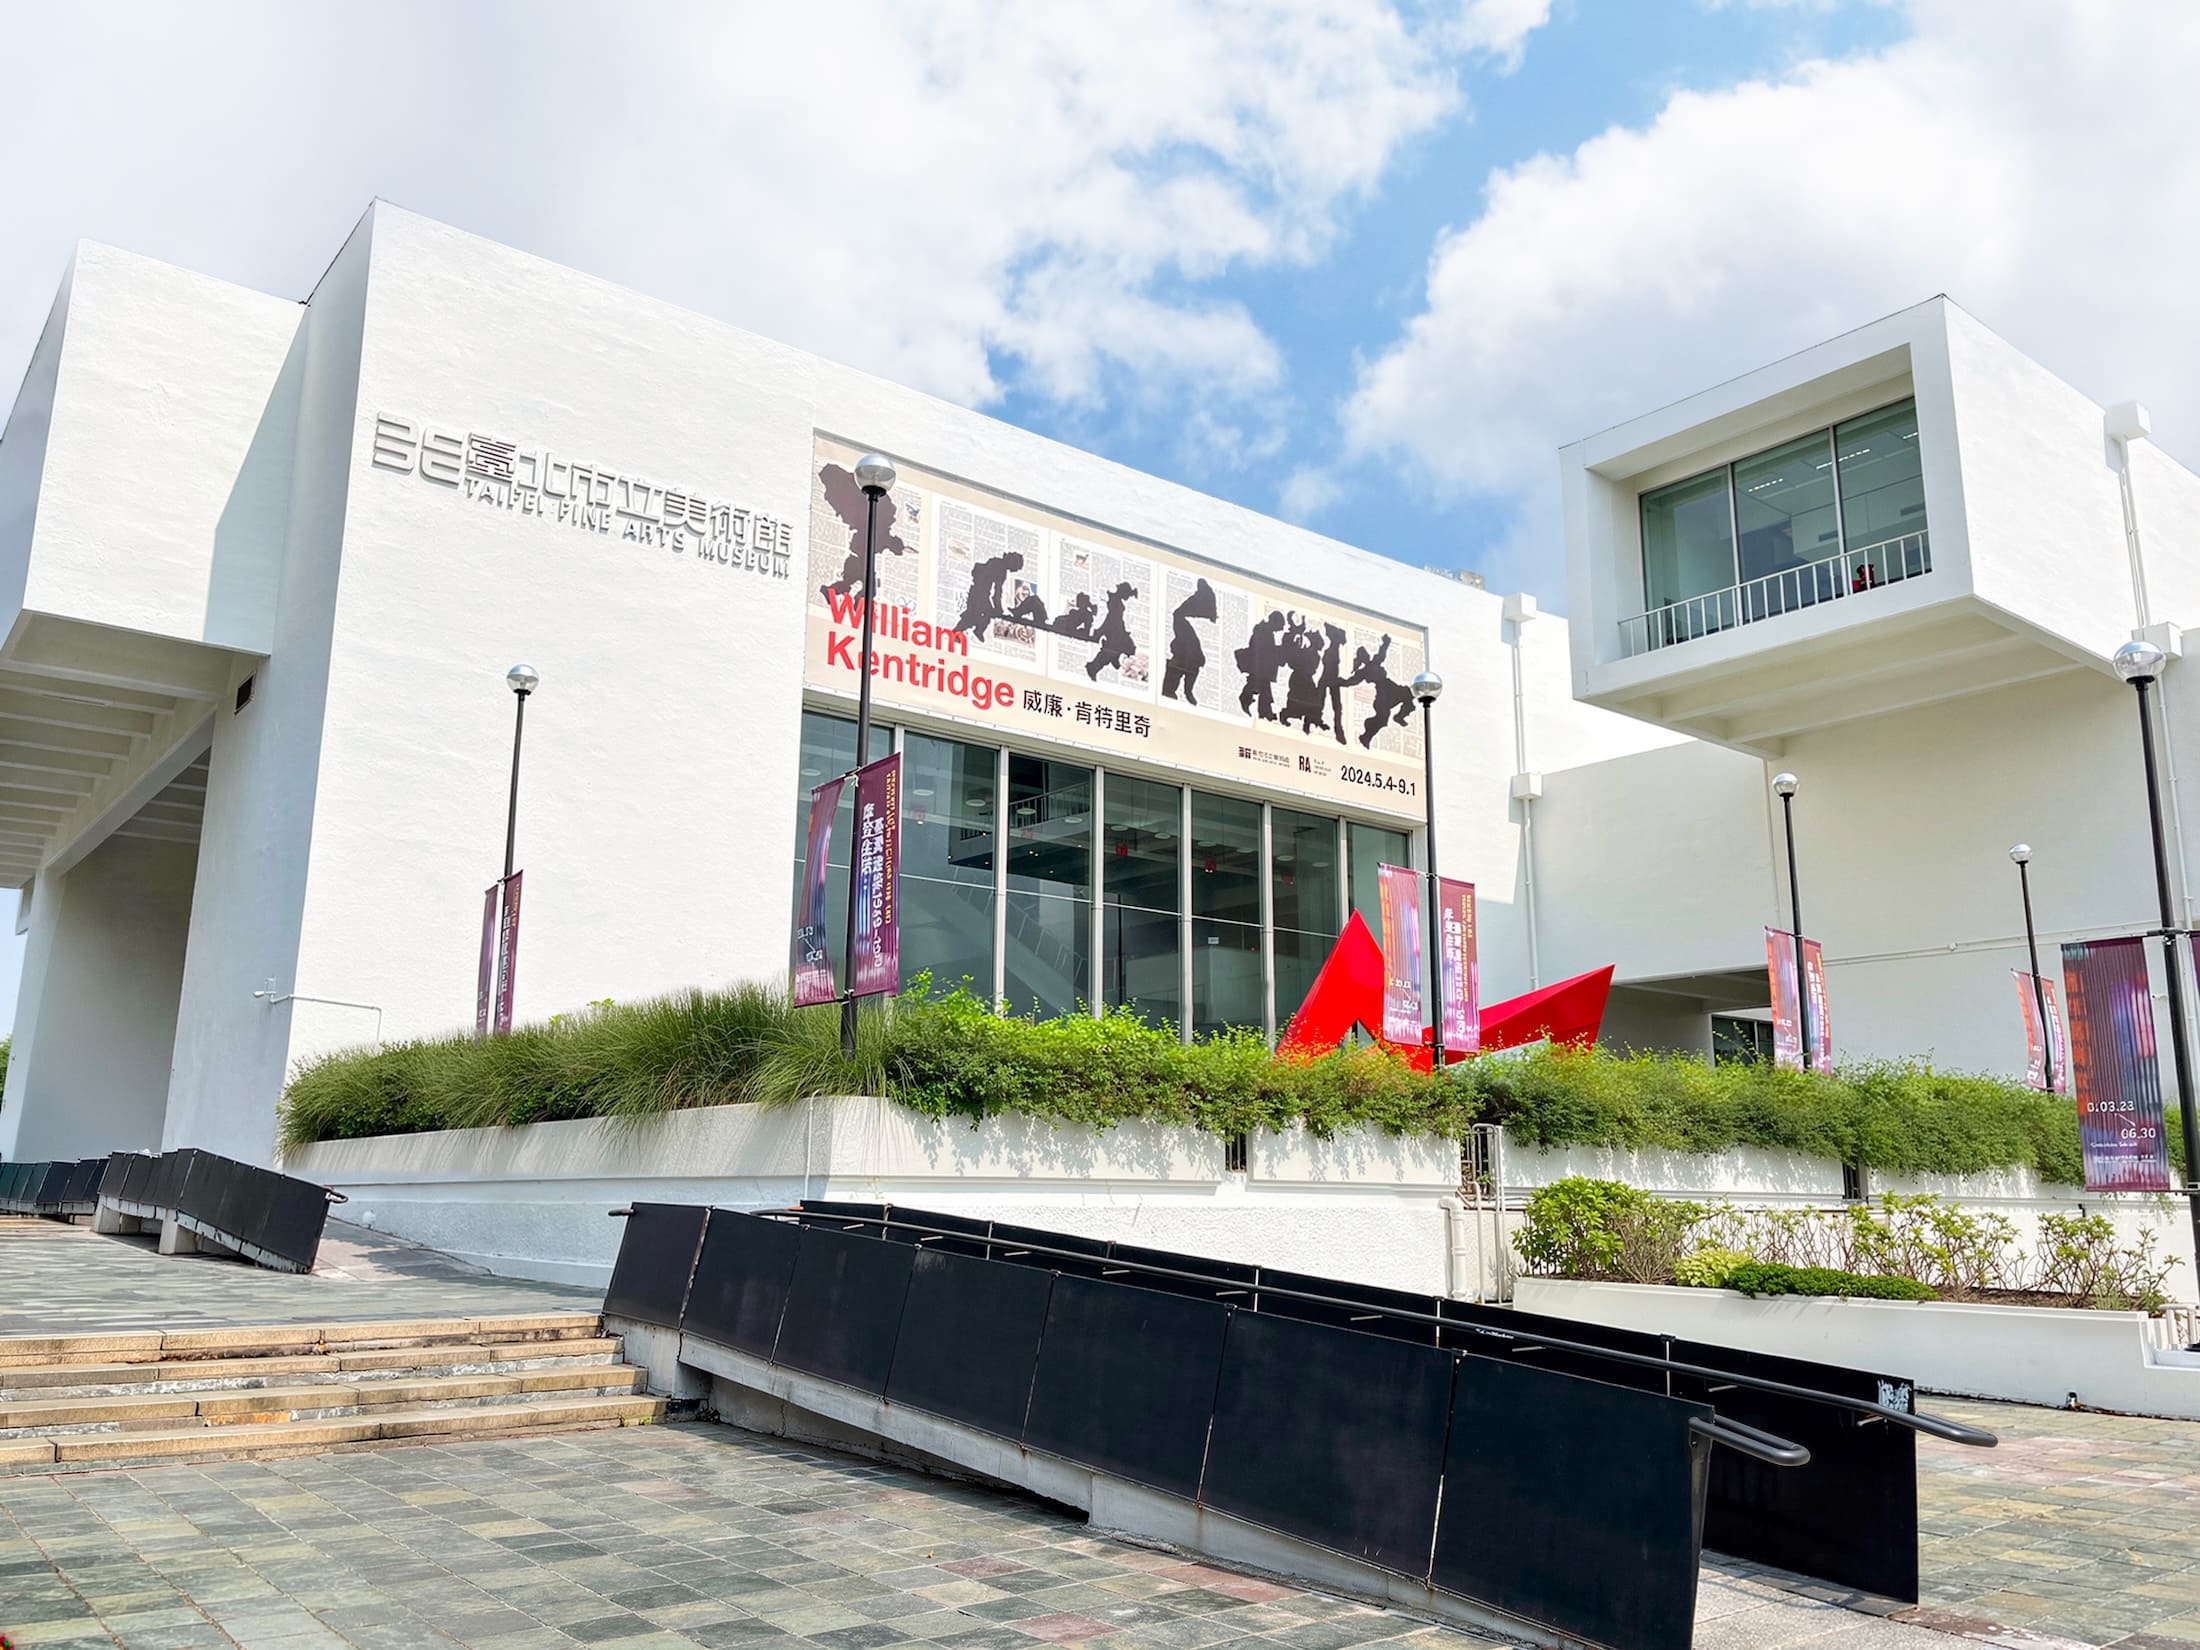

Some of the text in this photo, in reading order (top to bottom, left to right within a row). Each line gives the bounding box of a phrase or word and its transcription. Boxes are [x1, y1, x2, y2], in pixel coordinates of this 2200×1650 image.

[464, 475, 790, 580] TAIPEI FINE ARTS MUSEUM
[465, 430, 794, 557] 臺北市立美術館
[827, 586, 968, 657] William
[827, 630, 1015, 710] Kentridge
[1298, 755, 1311, 773] RA
[1341, 764, 1416, 797] 2024.5.4-9.1
[2121, 1128, 2156, 1139] 06.30
